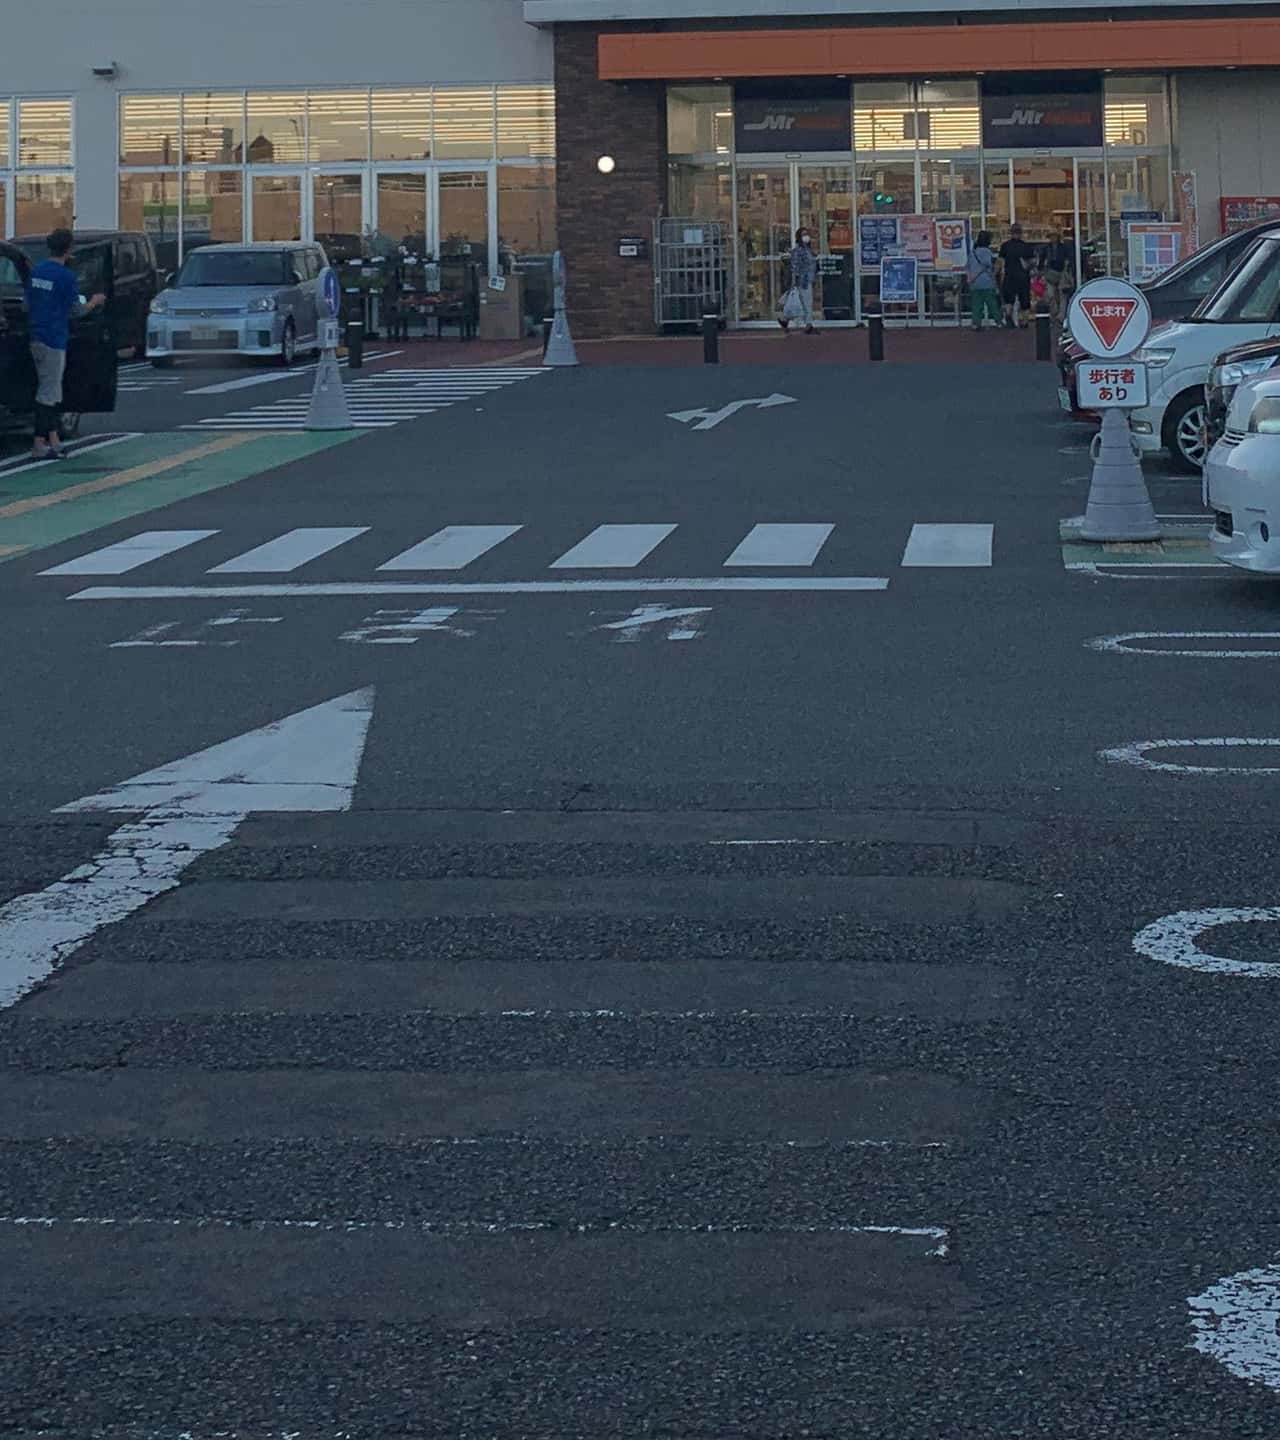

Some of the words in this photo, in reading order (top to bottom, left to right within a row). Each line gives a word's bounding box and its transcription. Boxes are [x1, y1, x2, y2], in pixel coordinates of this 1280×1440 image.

[1091, 304, 1127, 318] 止まれ
[1088, 368, 1136, 385] 歩行者
[1098, 386, 1128, 401] あり
